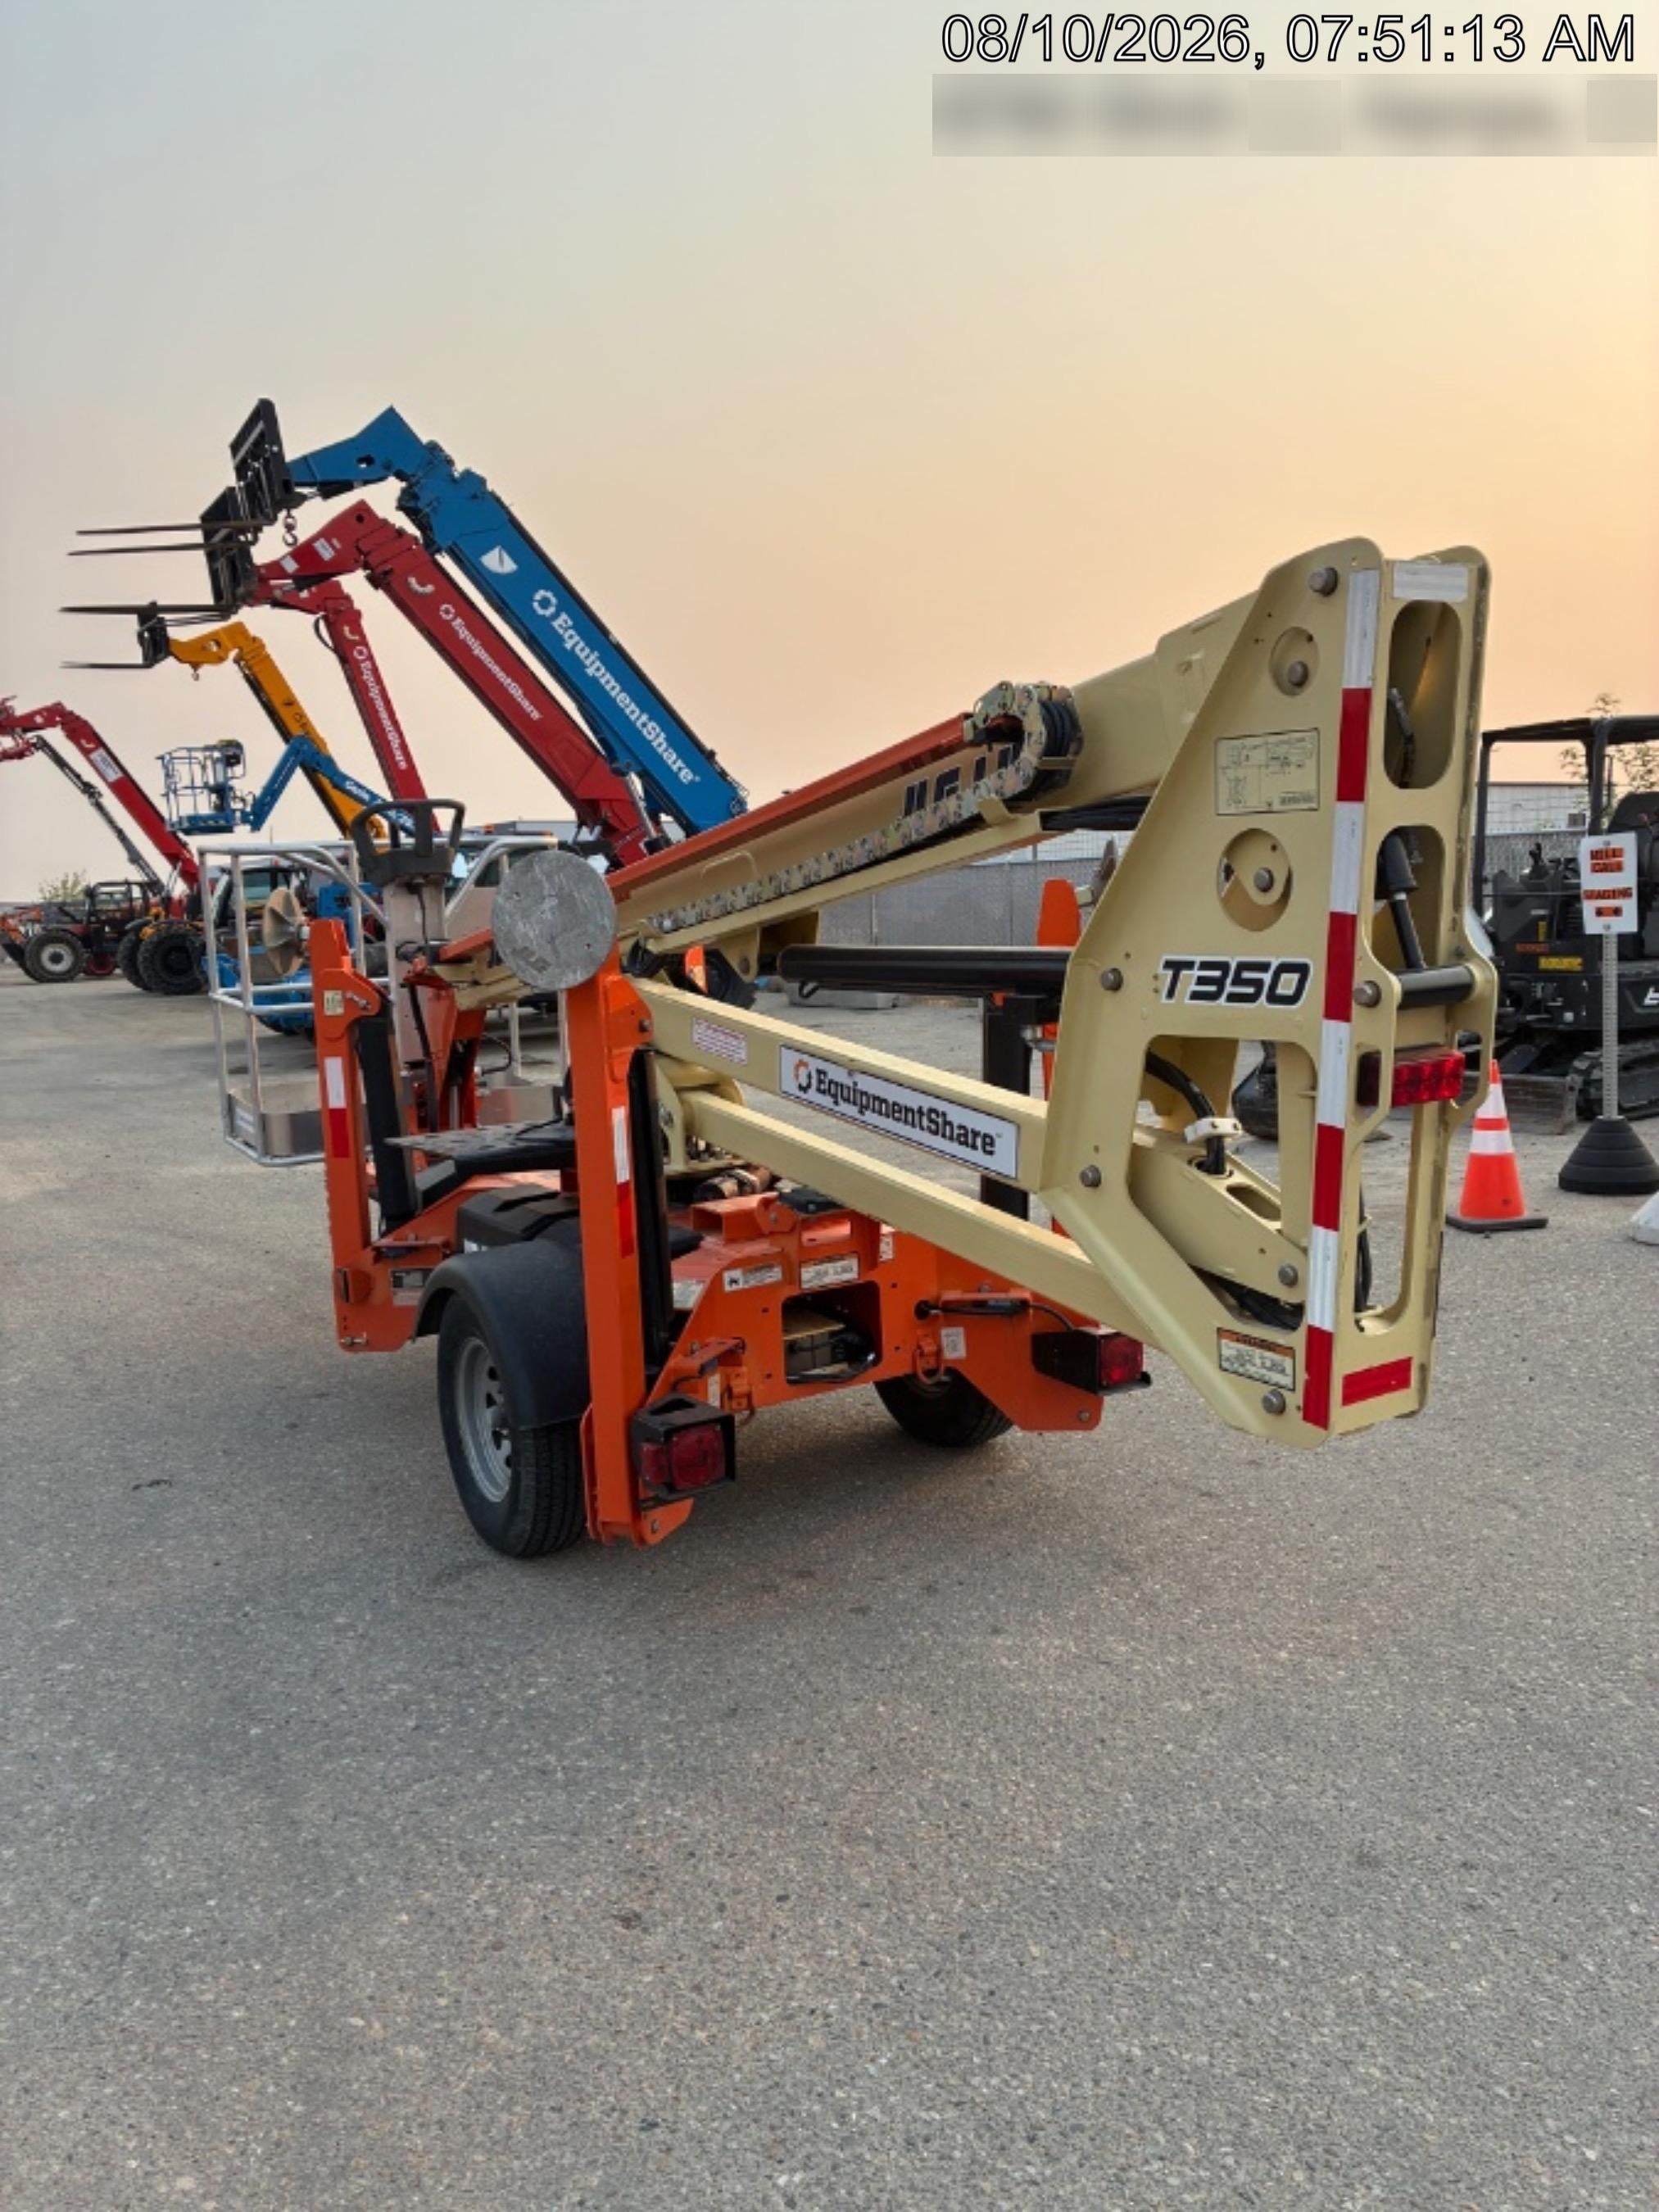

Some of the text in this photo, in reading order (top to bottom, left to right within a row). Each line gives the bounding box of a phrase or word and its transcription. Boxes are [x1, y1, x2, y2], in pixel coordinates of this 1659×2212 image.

[551, 610, 696, 785] EquipmentShare
[1161, 958, 1312, 1006] T350
[814, 1067, 997, 1157] EquipmentShare
